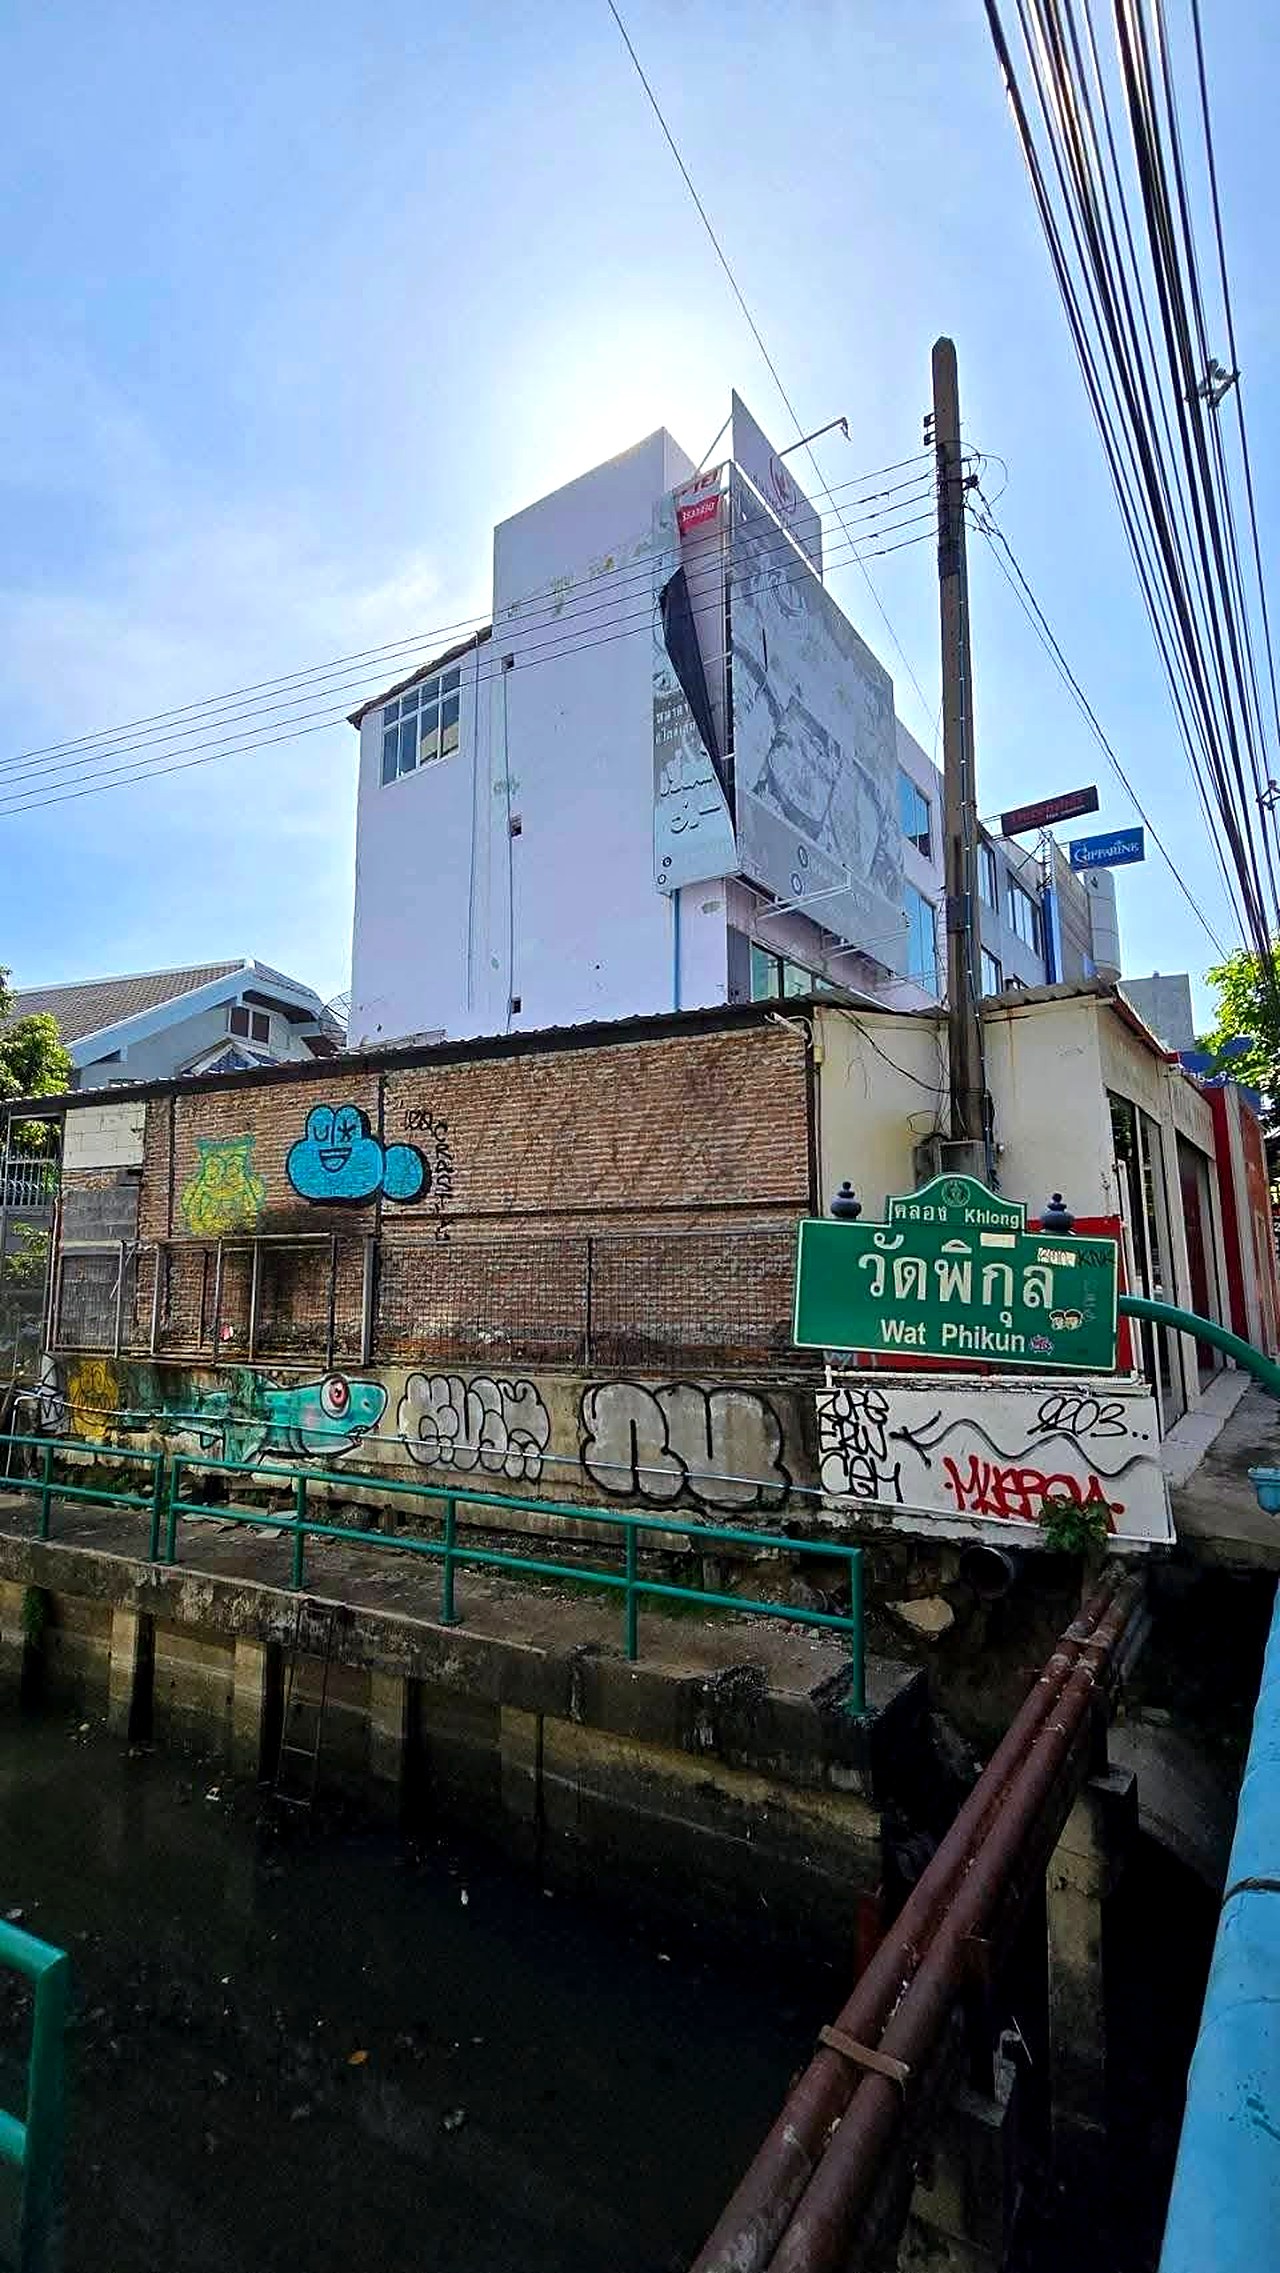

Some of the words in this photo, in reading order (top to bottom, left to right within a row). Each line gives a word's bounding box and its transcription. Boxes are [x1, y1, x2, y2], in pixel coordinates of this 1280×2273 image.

[894, 1203, 948, 1221] คลอง
[964, 1208, 1019, 1229] Khlong
[858, 1232, 1054, 1329] วัดพิกุล
[881, 1318, 926, 1345] Wat
[941, 1323, 1026, 1353] Phikun
